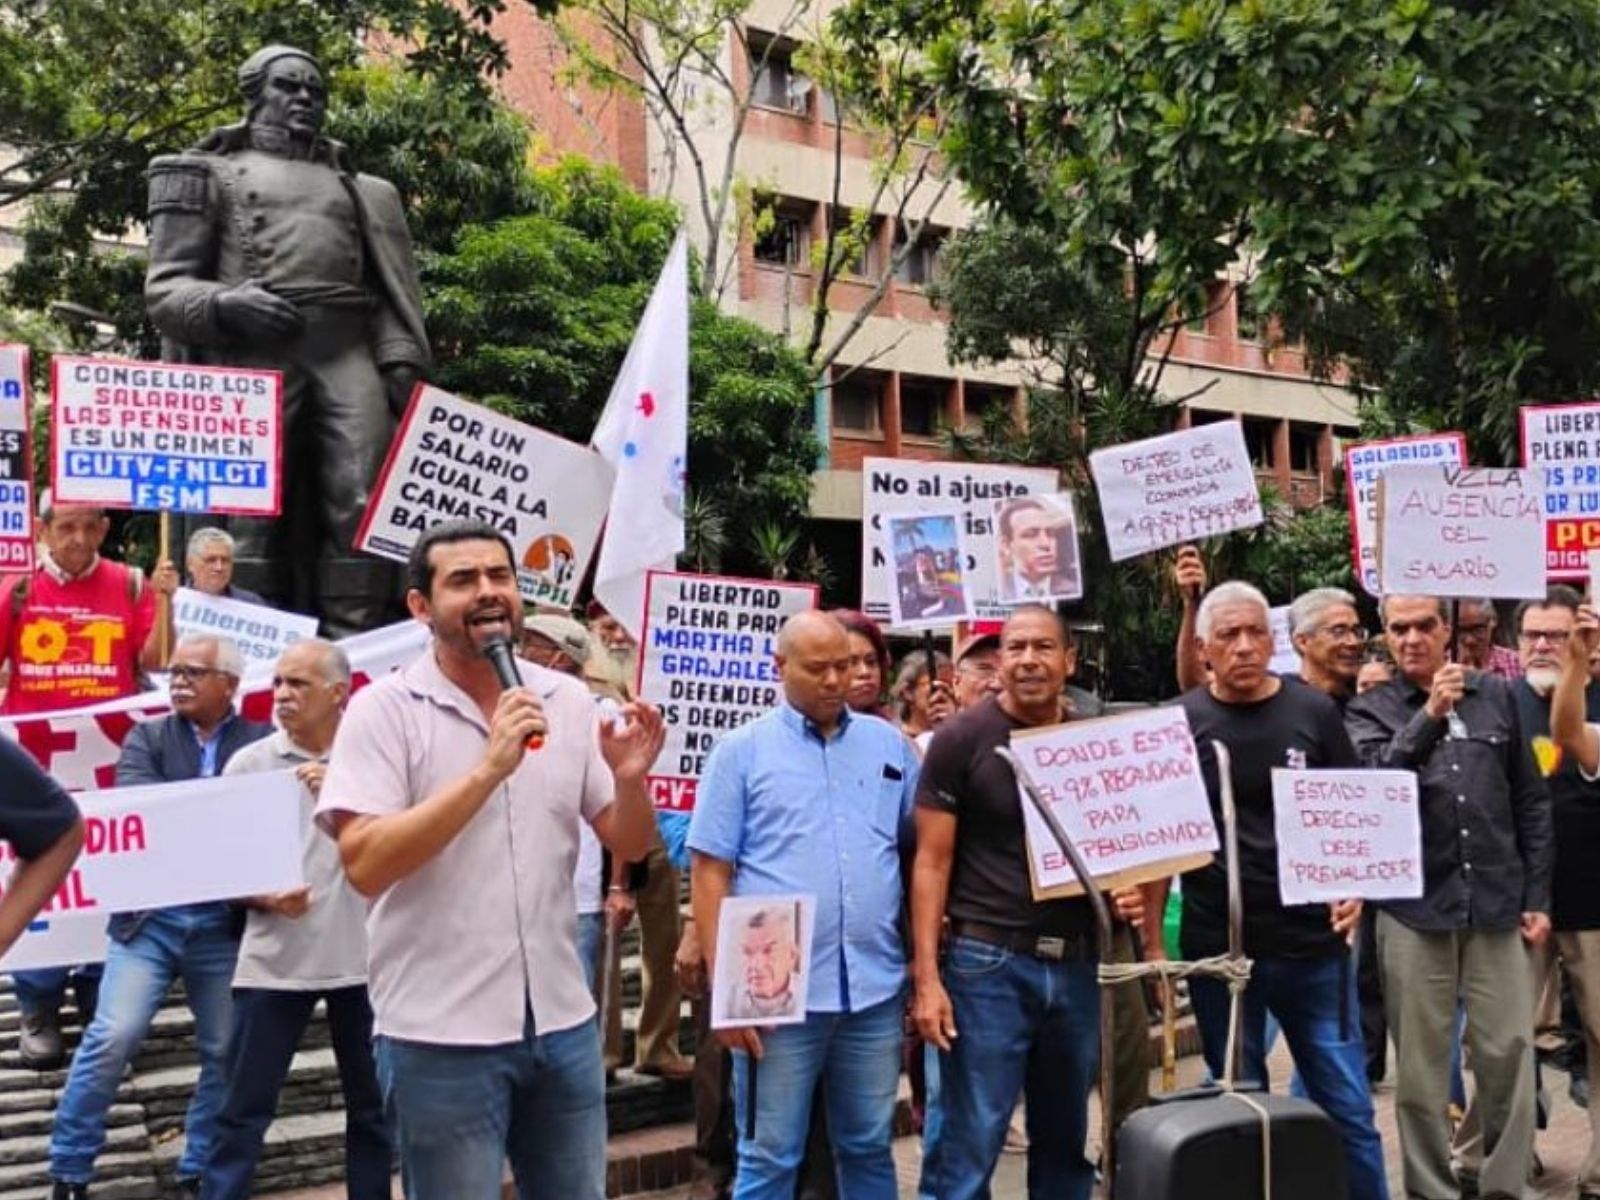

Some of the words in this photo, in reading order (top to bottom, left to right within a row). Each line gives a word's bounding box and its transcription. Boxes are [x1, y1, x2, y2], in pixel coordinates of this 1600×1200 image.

[75, 365, 214, 390] CONGELAR
[222, 377, 267, 395] LOS
[96, 388, 223, 412] SALARIOS
[234, 397, 245, 414] Y
[64, 407, 111, 425] LAS
[121, 410, 269, 437] PENSIONES
[429, 406, 483, 441] POR
[490, 428, 526, 455] UN
[70, 428, 103, 446] ES
[112, 431, 146, 448] UN
[155, 434, 254, 456] CRIMEN
[1353, 443, 1443, 465] SALARIOS
[1531, 440, 1588, 461] PLENA
[69, 453, 262, 485] CUTV-FNLCT
[418, 431, 529, 483] SALARIO
[409, 455, 483, 497] IGUAL
[489, 488, 508, 506] A
[516, 493, 548, 519] LA
[872, 472, 908, 494] No
[917, 475, 940, 497] al
[949, 476, 1029, 502] ajuste
[1440, 461, 1523, 488] VZLA
[136, 485, 205, 509] FSM
[400, 482, 517, 536] CANASTA
[1442, 526, 1488, 543] DEL
[680, 581, 781, 608] LIBERTAD
[180, 603, 279, 641] Liberen
[666, 606, 729, 629] PLENA
[655, 628, 753, 653] MARTHA
[670, 680, 777, 706] DEFENDER
[1034, 738, 1125, 768] DONDE
[1064, 775, 1099, 802] 9%
[1294, 780, 1367, 801] ESTADO
[1384, 786, 1412, 803] DE
[1083, 804, 1140, 830] PARA
[1300, 809, 1382, 828] DERECHO
[1321, 840, 1371, 858] DEBE
